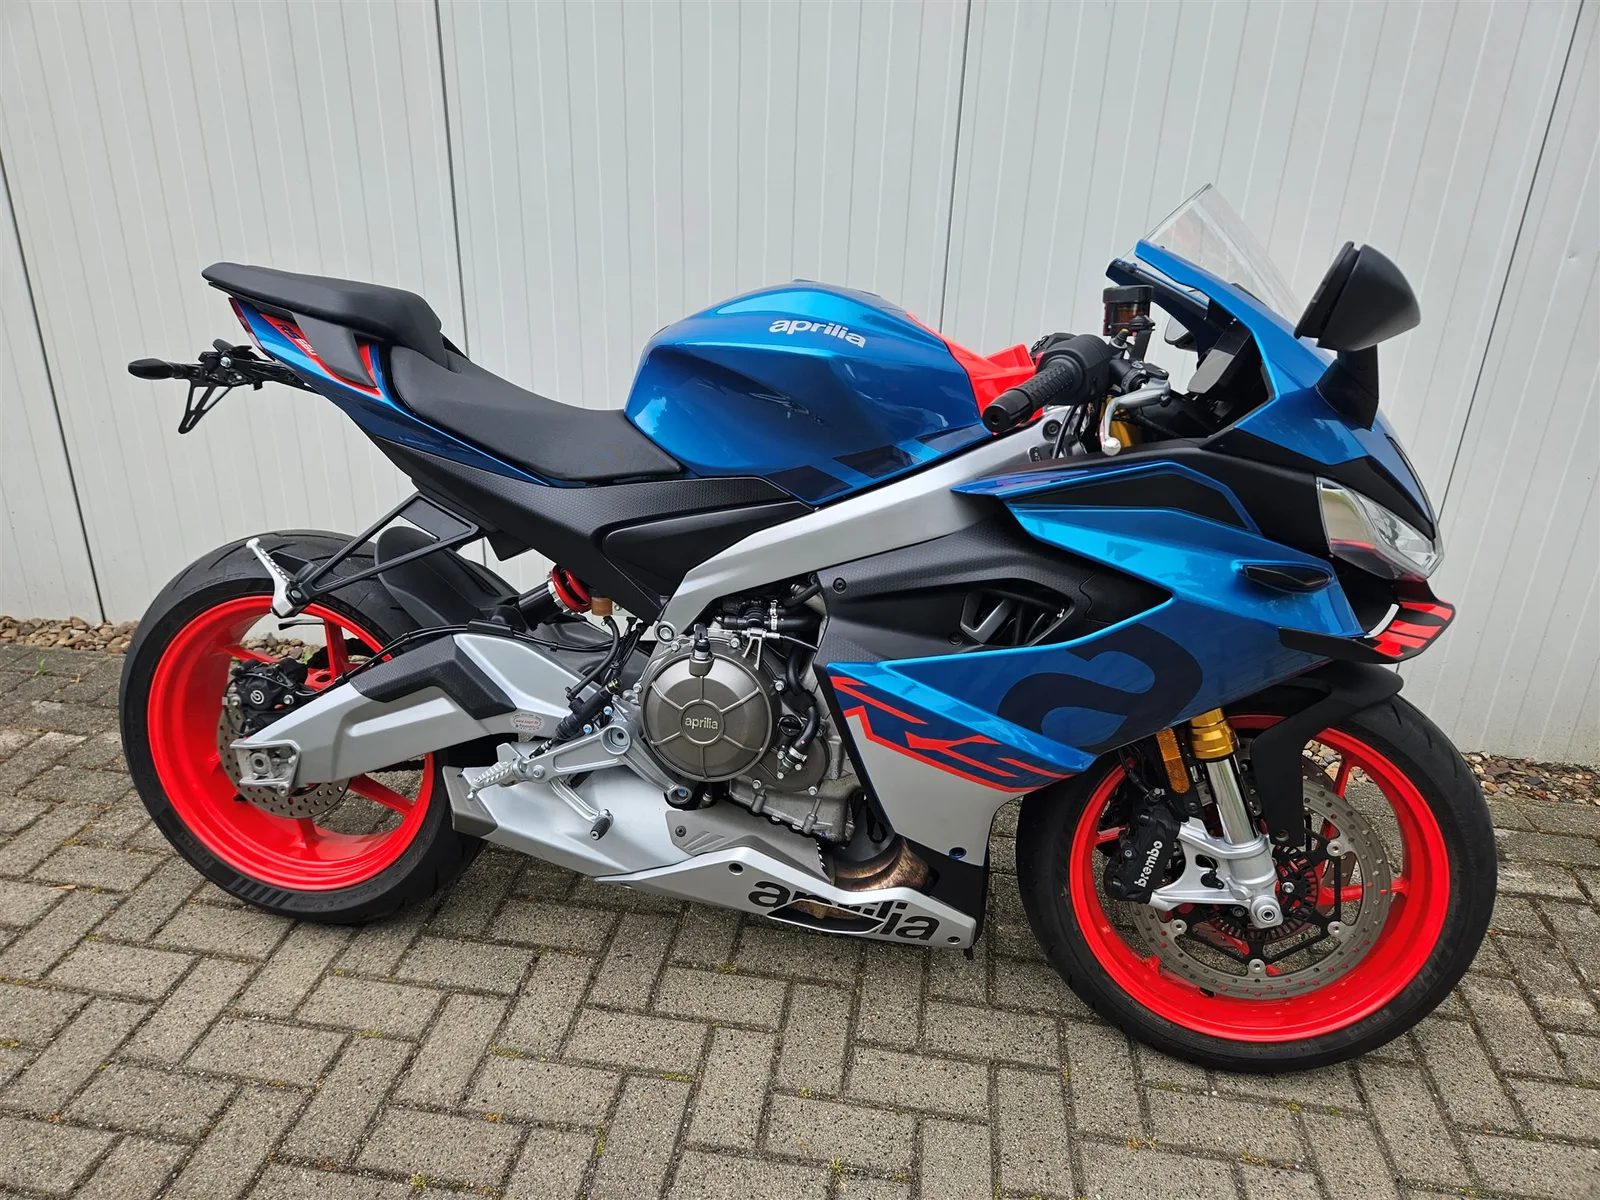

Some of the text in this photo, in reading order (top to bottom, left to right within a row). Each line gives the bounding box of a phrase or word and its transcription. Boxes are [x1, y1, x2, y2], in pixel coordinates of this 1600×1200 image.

[769, 320, 866, 348] aprilia
[684, 717, 719, 730] aprilia
[1134, 840, 1163, 888] brembo
[748, 881, 940, 941] alia
